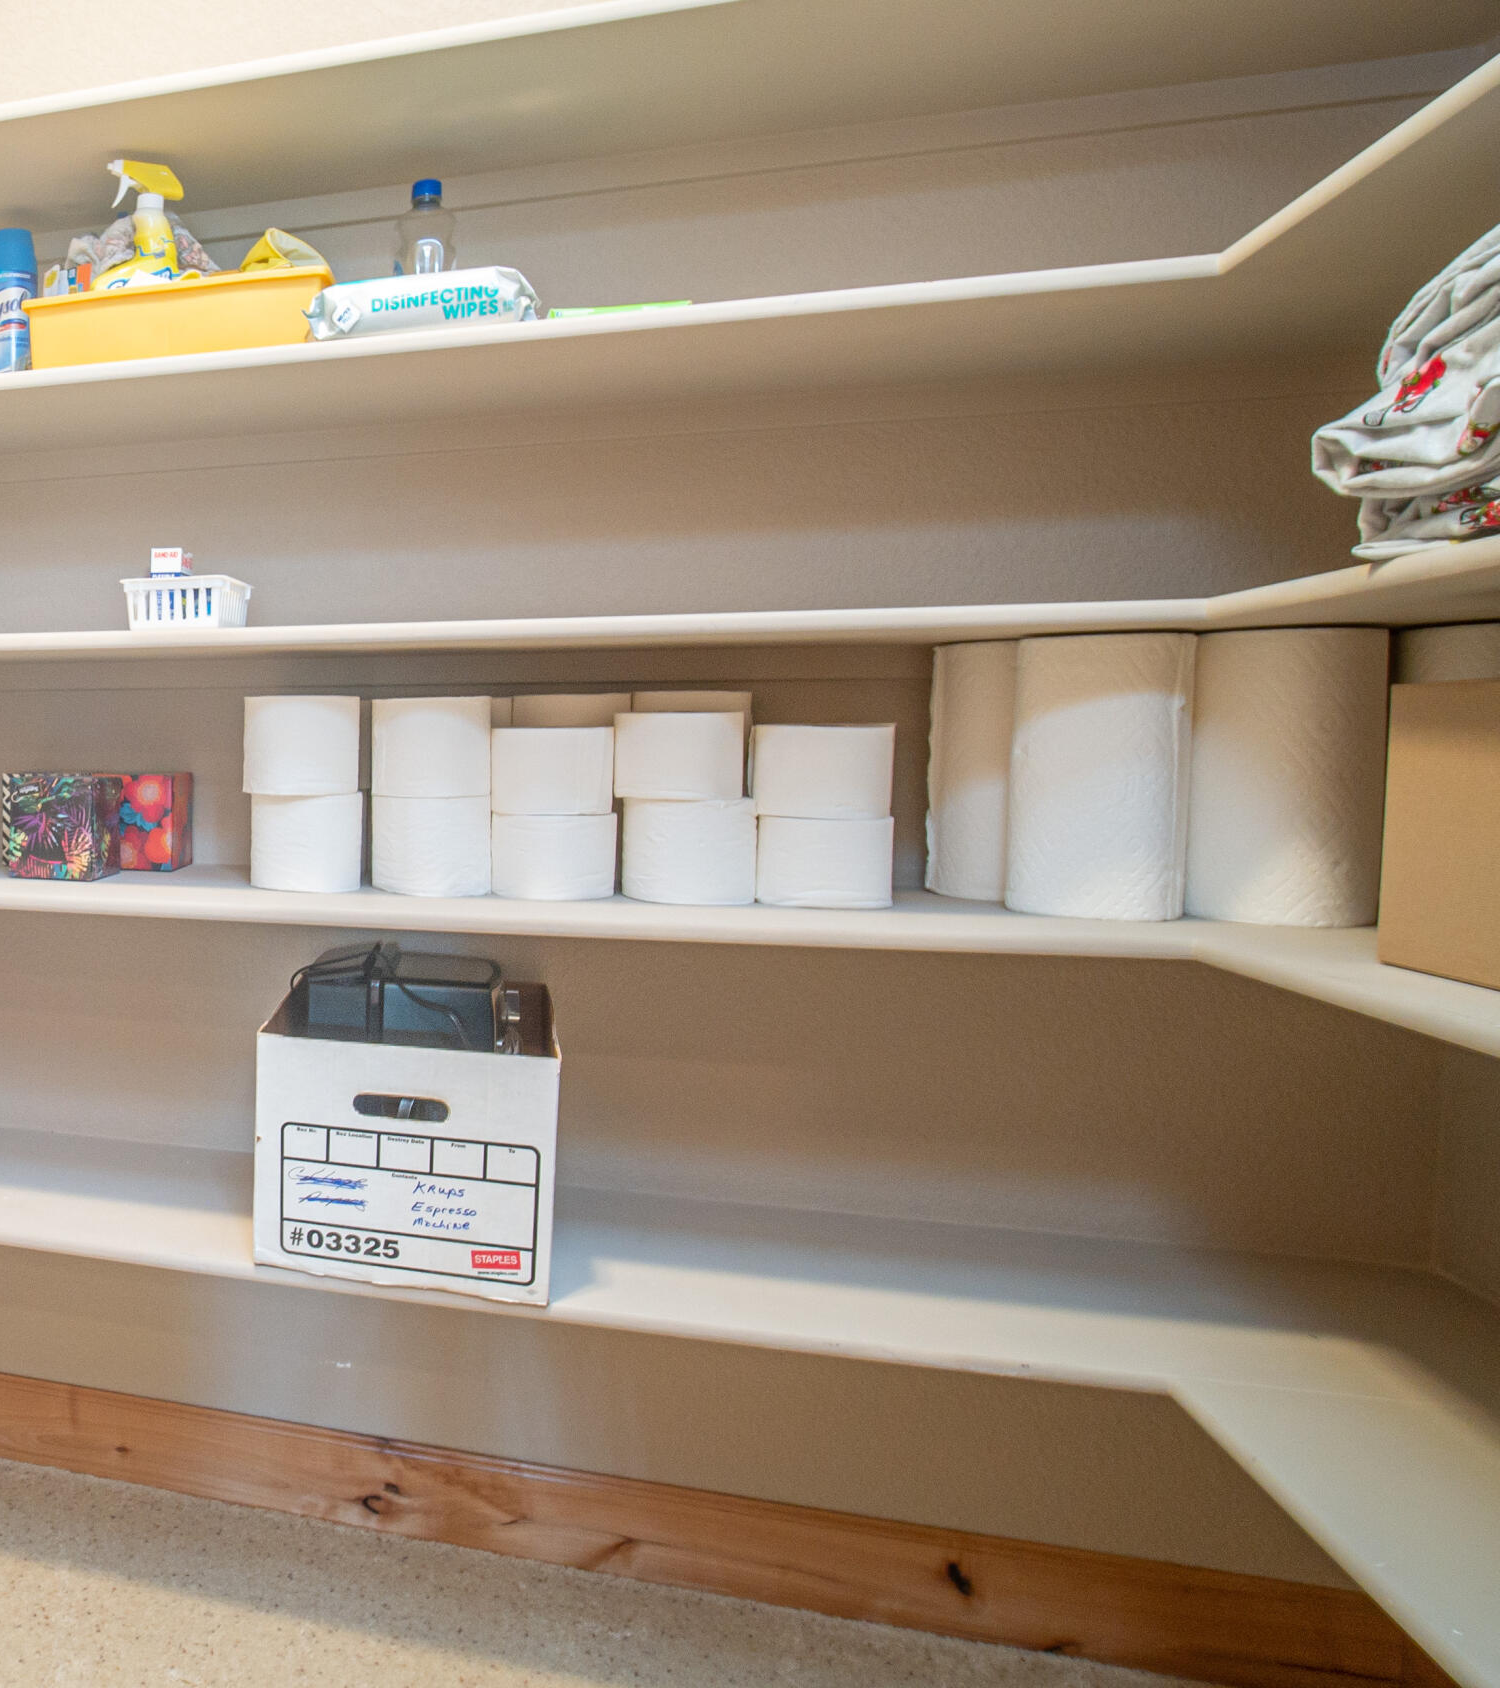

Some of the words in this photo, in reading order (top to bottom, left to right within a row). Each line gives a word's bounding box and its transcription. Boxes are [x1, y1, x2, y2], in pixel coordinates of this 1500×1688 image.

[371, 285, 499, 313] DISINFECTING
[443, 299, 499, 320] WIPES
[411, 1201, 477, 1217] Espresso
[290, 1226, 400, 1259] #03325
[474, 1254, 518, 1265] STAPLES
